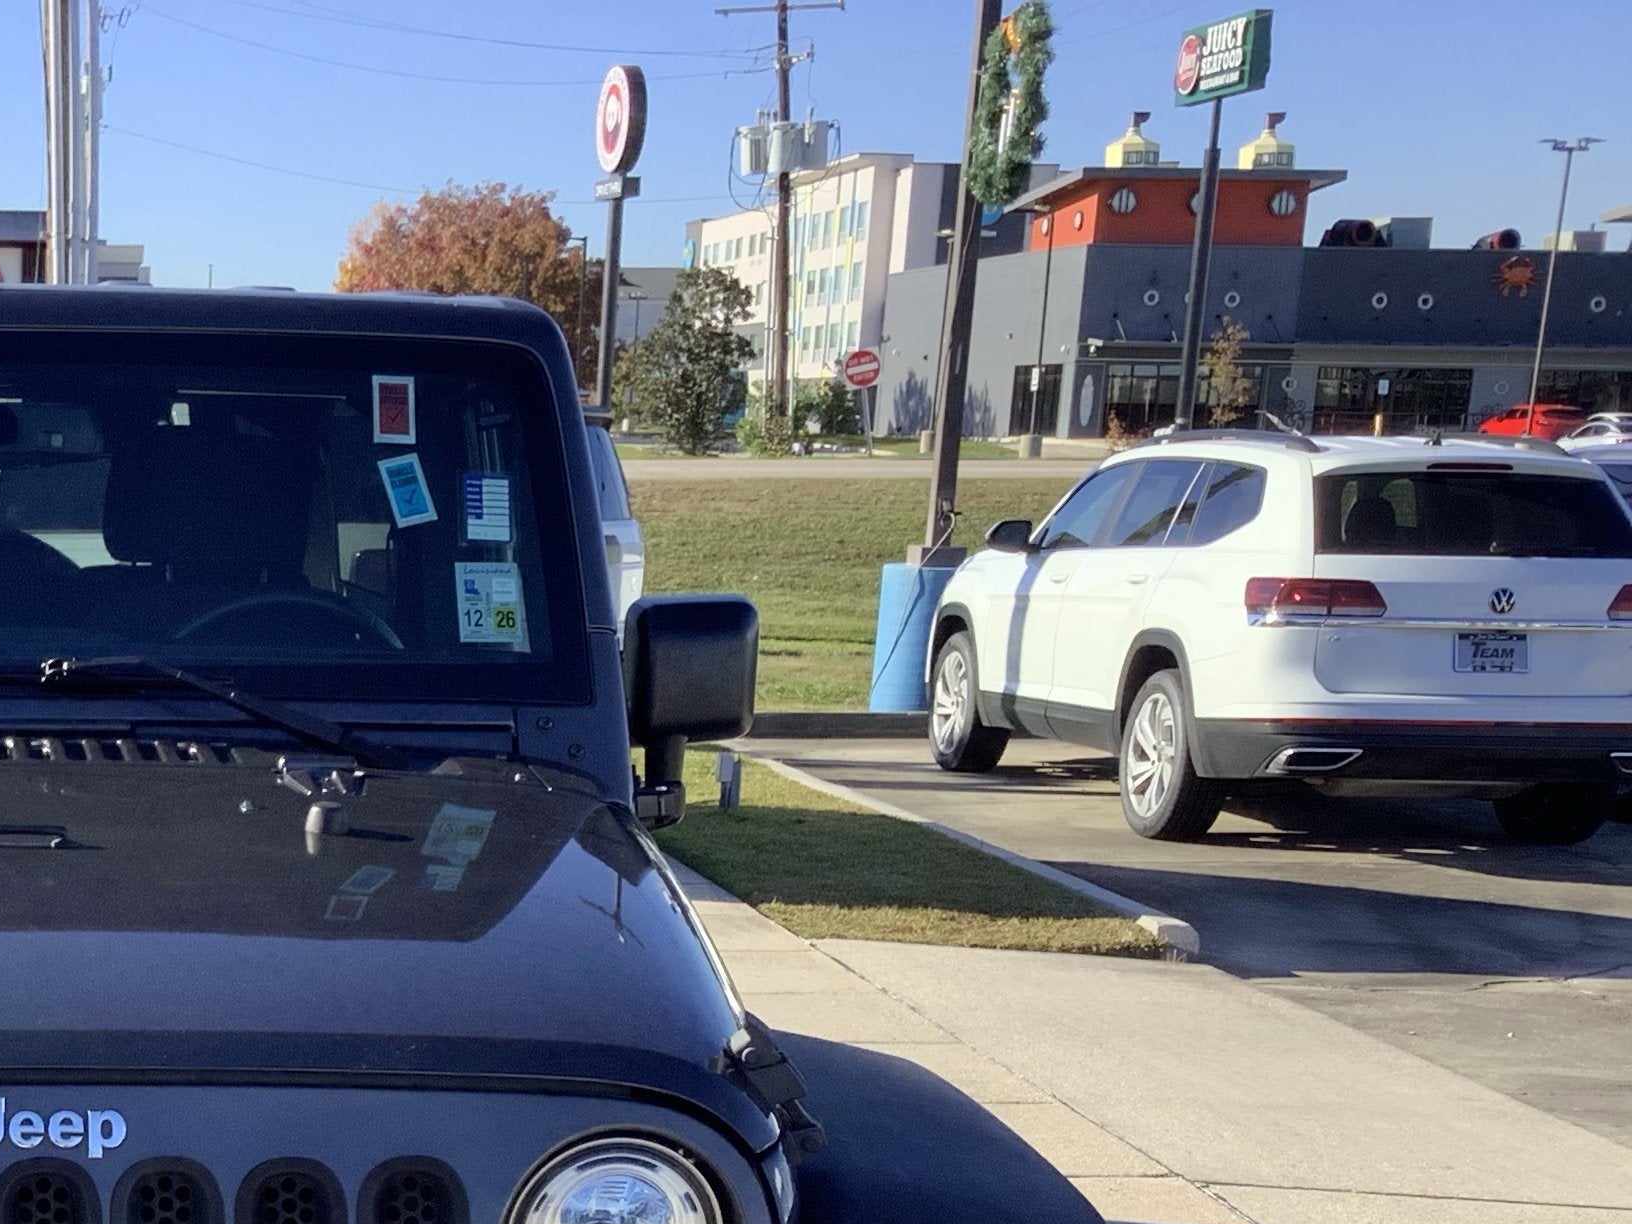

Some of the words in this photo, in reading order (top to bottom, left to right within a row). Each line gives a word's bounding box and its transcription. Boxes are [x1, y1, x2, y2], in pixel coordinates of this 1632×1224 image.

[1202, 17, 1247, 56] JUICY
[1200, 47, 1243, 77] SEAFOOD
[464, 609, 484, 627] 12
[495, 610, 516, 629] 26
[1471, 641, 1515, 659] TEAM
